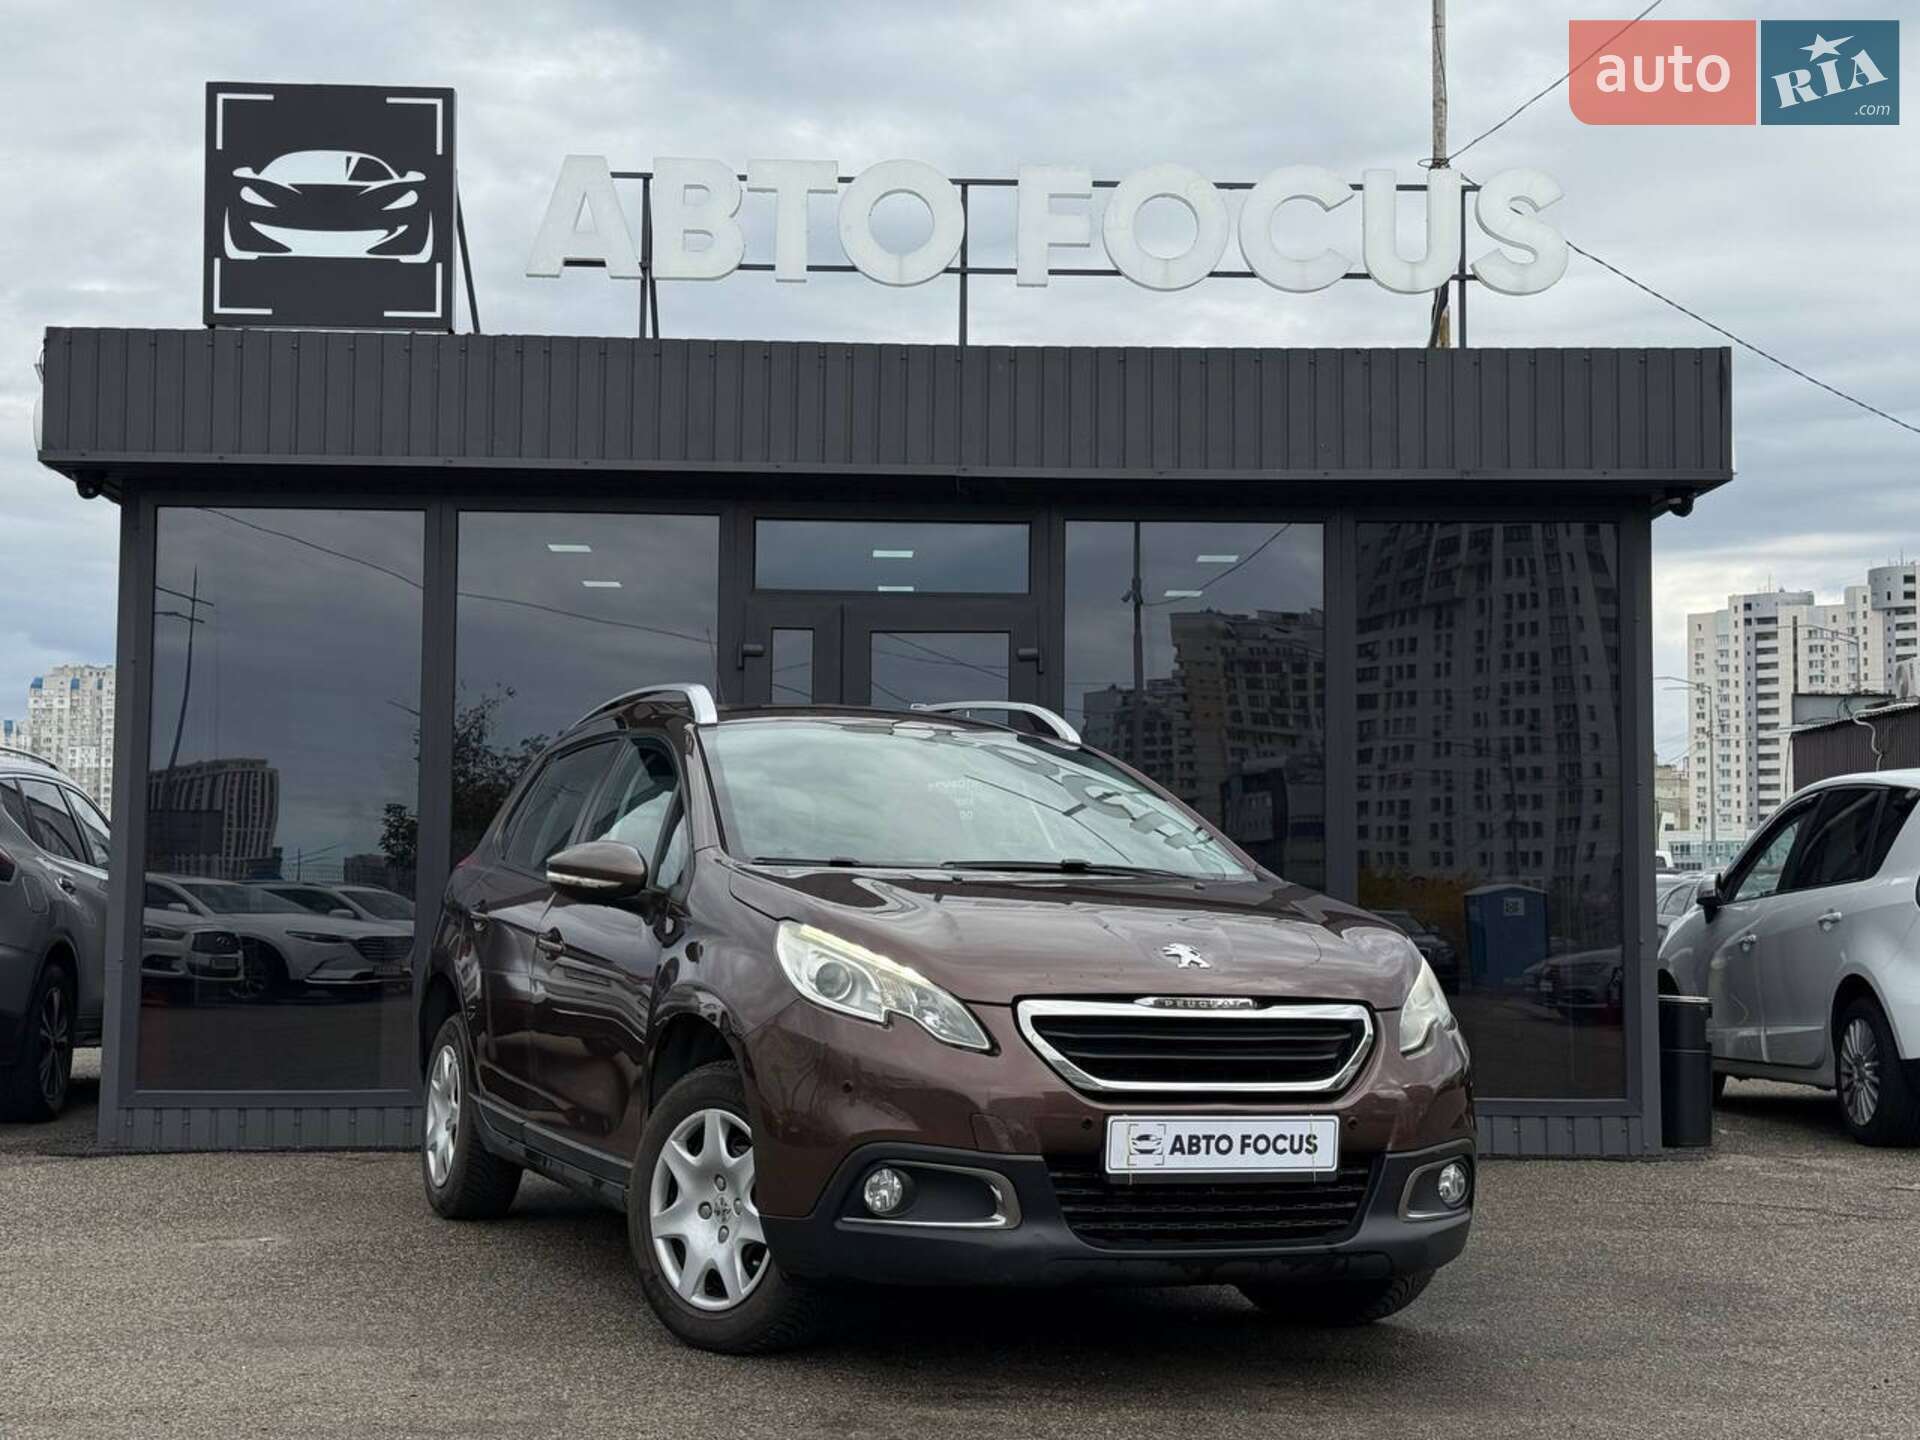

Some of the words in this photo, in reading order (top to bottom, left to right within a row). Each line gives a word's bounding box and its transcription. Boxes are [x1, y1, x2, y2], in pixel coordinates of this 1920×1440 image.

[525, 154, 966, 287] АВТО
[1016, 163, 1570, 296] FOCUS
[1168, 1133, 1234, 1156] АВТО
[1239, 1133, 1319, 1156] FOCUS
